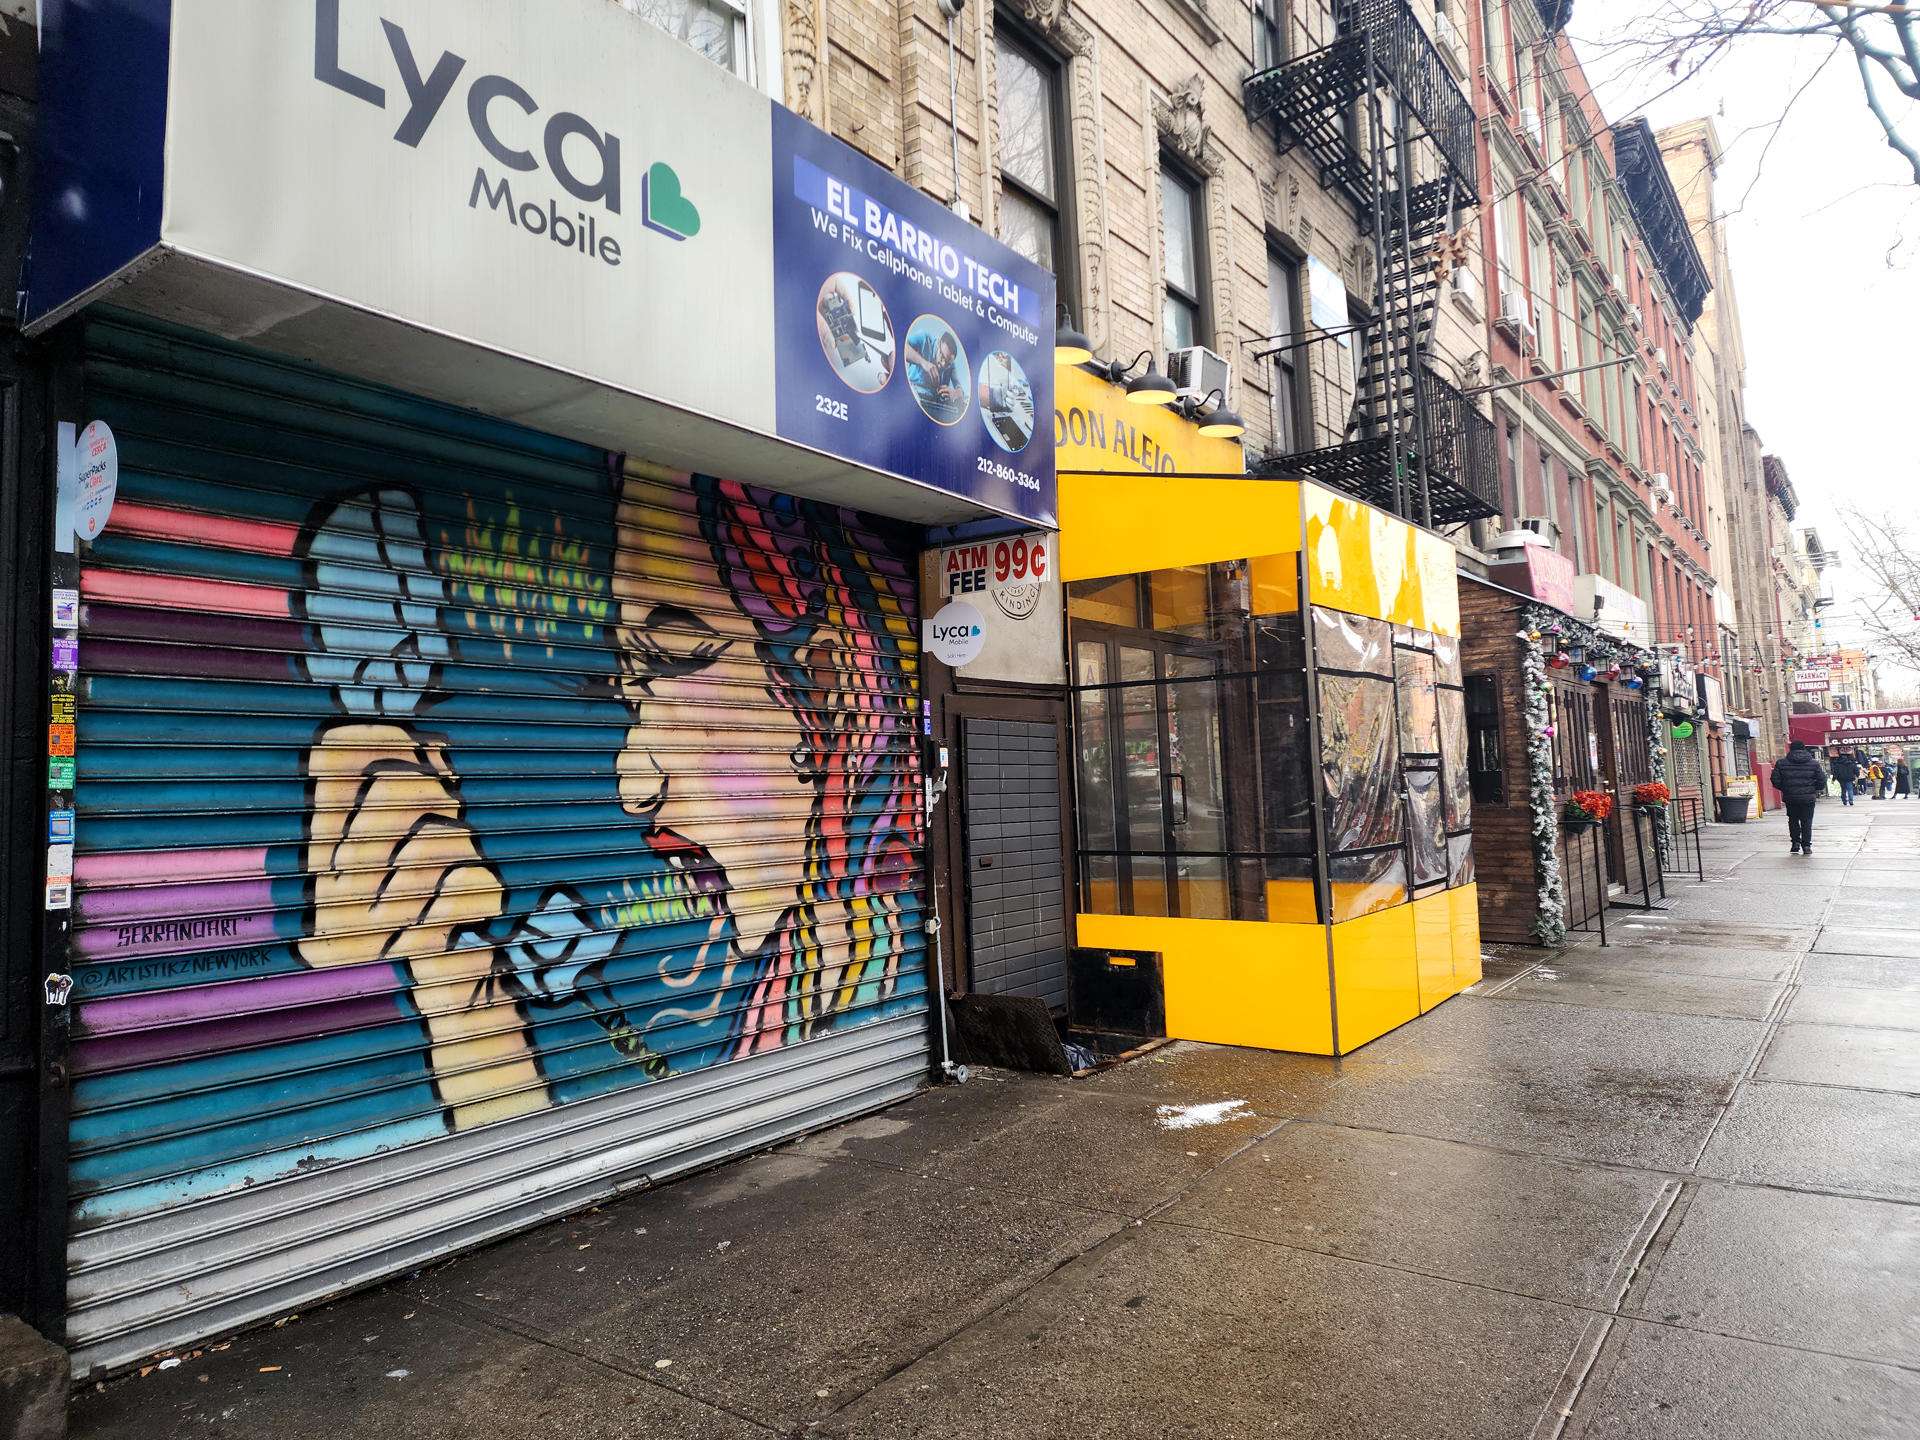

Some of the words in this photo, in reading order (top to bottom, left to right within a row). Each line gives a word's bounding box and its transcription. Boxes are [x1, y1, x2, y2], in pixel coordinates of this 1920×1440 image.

[314, 0, 621, 215] Lyca
[468, 167, 621, 266] Mobile
[827, 177, 858, 227] EL
[865, 199, 959, 280] BARRIO
[964, 255, 1019, 314] TECH
[811, 207, 838, 239] We
[843, 224, 863, 253] Fix
[867, 242, 933, 291] Cellphone
[937, 276, 973, 313] Tablet
[976, 300, 985, 317] &
[988, 307, 1039, 347] Computer
[815, 394, 849, 422] 232E
[977, 457, 1041, 492] 212-860-3364
[946, 544, 988, 572] ATM
[950, 568, 986, 594] FEE
[933, 625, 968, 641] Lyca
[1797, 681, 1828, 691] FARMACIA
[1830, 714, 1919, 731] FARMACI
[1868, 735, 1906, 743] FUNERAL
